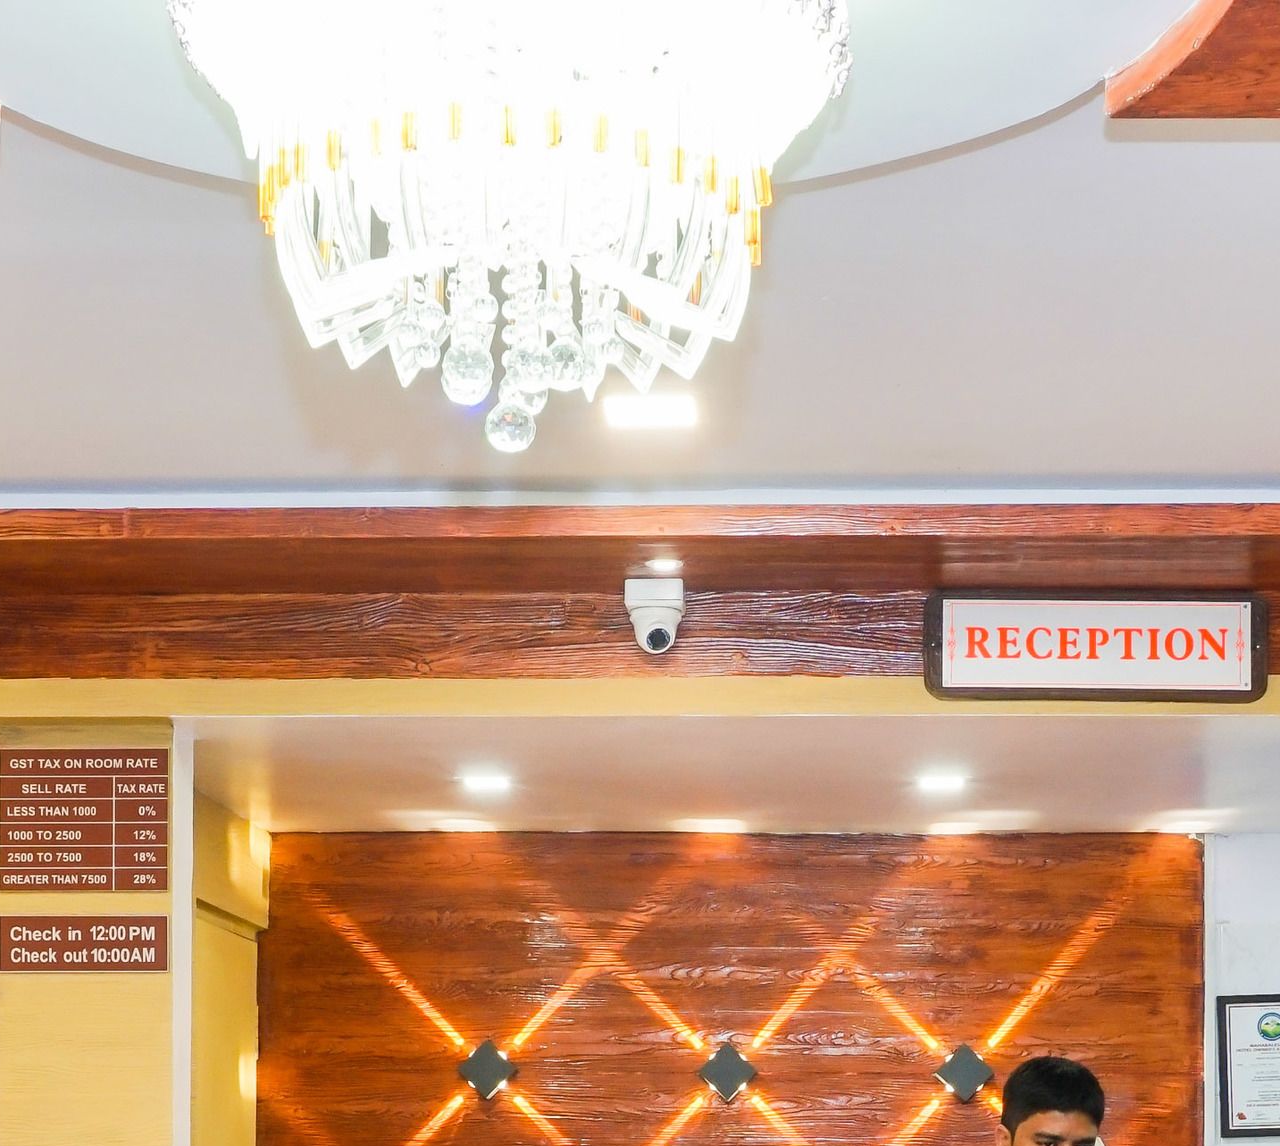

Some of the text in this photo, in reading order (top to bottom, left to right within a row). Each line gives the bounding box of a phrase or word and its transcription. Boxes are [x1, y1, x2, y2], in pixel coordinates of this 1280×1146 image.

[964, 626, 1229, 661] RECEPTION
[9, 758, 158, 769] GST TAX ON ROOM RATE
[21, 783, 87, 794] SELL RATE
[117, 783, 165, 794] TAX RATE
[6, 806, 97, 817] LESS THAN 1000
[138, 805, 156, 816] 0%
[7, 830, 82, 840] 1000 TO 2500
[133, 830, 156, 840] 12%
[7, 852, 82, 862] 2500 TO 7500
[133, 852, 156, 862] 18%
[2, 874, 107, 885] GREATER THAN 7500
[133, 874, 156, 884] 28%
[9, 926, 156, 941] Check in 12:00 PM
[10, 947, 57, 963] Check
[63, 948, 87, 963] out
